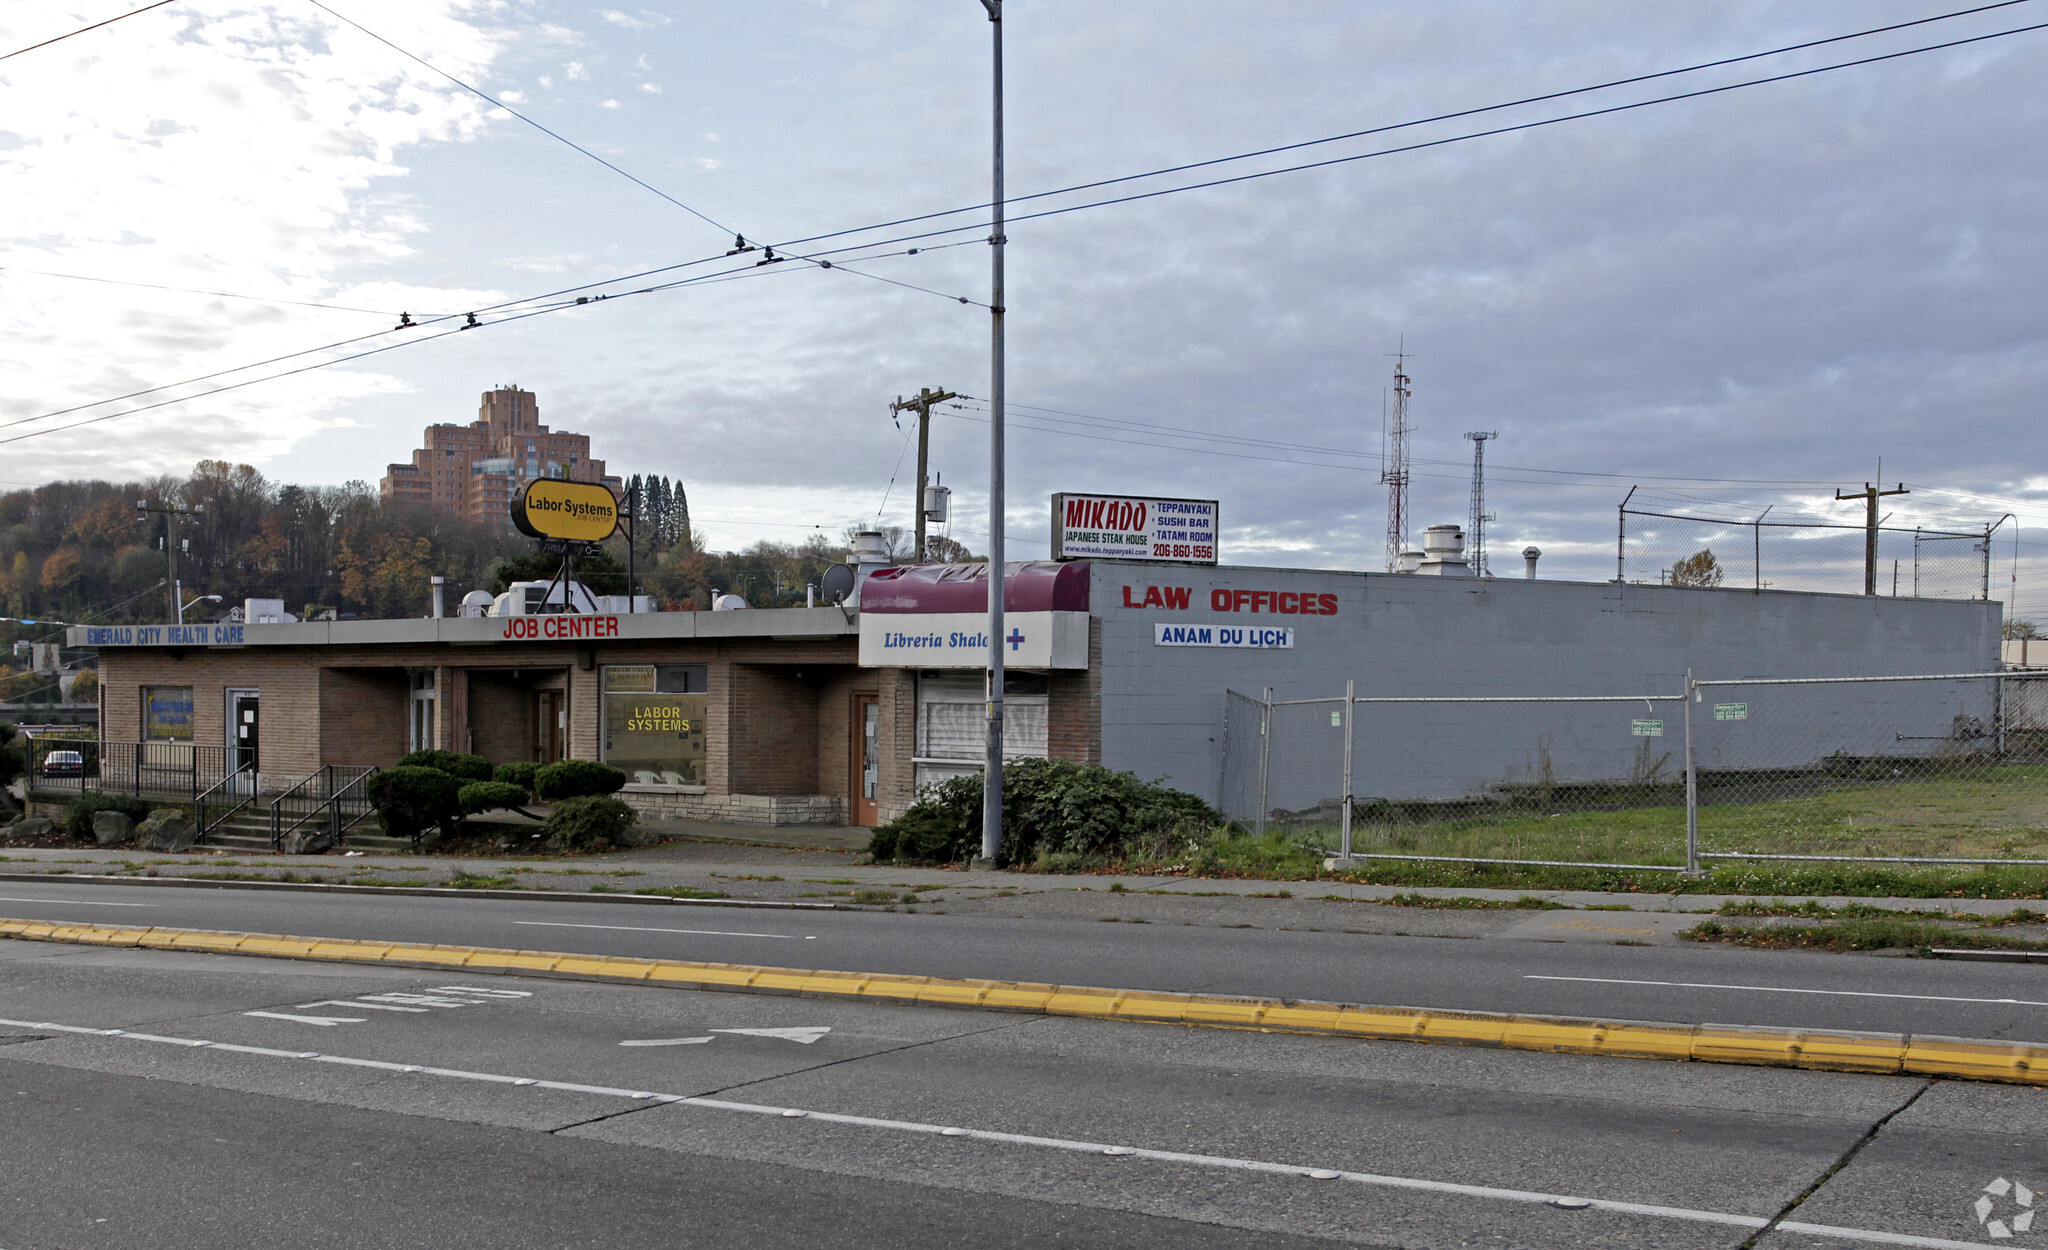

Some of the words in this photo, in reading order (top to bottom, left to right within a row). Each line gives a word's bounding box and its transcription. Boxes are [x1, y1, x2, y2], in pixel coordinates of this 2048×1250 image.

[528, 495, 563, 512] Labor
[564, 499, 613, 517] Systems
[1157, 502, 1212, 515] TEPPANYAKI
[1066, 499, 1147, 531] MIKADO
[1157, 516, 1187, 527] SUSHI
[1189, 518, 1209, 528] BAR
[1064, 531, 1100, 543] JAPANESE
[1101, 532, 1124, 545] STEAK
[1125, 534, 1148, 545] HOUSE
[1156, 530, 1188, 541] TATAMI
[1189, 532, 1213, 542] ROOM
[1064, 545, 1148, 556] www.mikado.teppanyaki.com
[1153, 543, 1213, 559] 206-860-1556
[1122, 585, 1192, 610] LAW
[1211, 588, 1338, 615] OFFICES
[88, 627, 132, 644] EMERALD
[137, 627, 161, 645] CITY
[168, 626, 208, 643] HEALTH
[214, 625, 244, 643] CARE
[503, 618, 539, 639] JOB
[544, 616, 619, 638] CENTER
[1161, 627, 1212, 643] ANAM
[1219, 629, 1243, 644] DU
[884, 632, 943, 648] Libreria
[635, 706, 681, 719] LABOR
[627, 719, 690, 731] SYSTEMS
